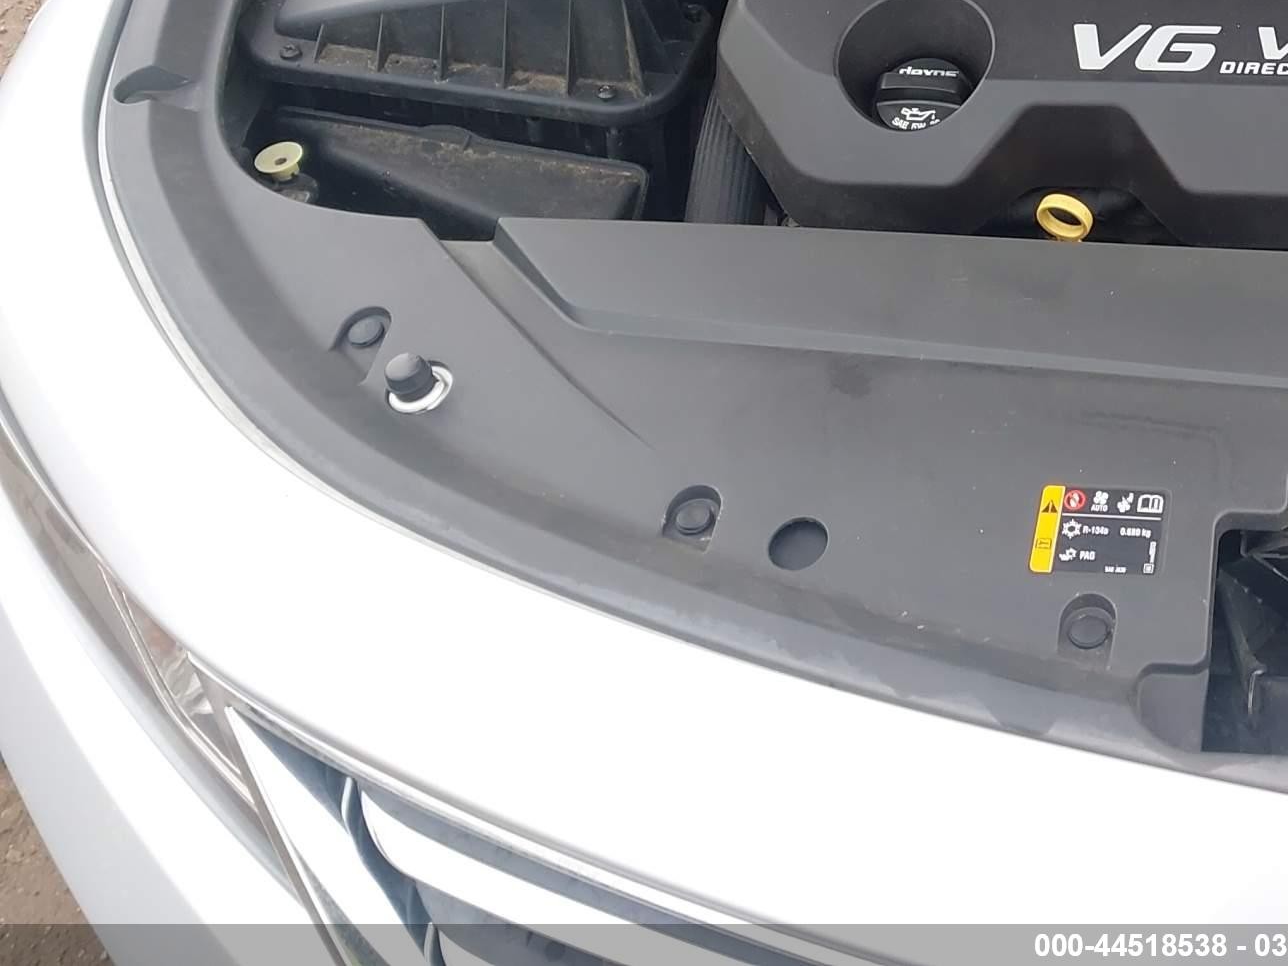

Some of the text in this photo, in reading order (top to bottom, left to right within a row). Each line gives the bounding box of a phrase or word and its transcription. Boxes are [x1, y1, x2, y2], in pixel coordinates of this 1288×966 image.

[1073, 23, 1223, 72] V6
[892, 117, 909, 130] SAE
[1091, 504, 1108, 512] AUTO
[1083, 525, 1109, 535] R-134a
[1142, 528, 1151, 538] kg
